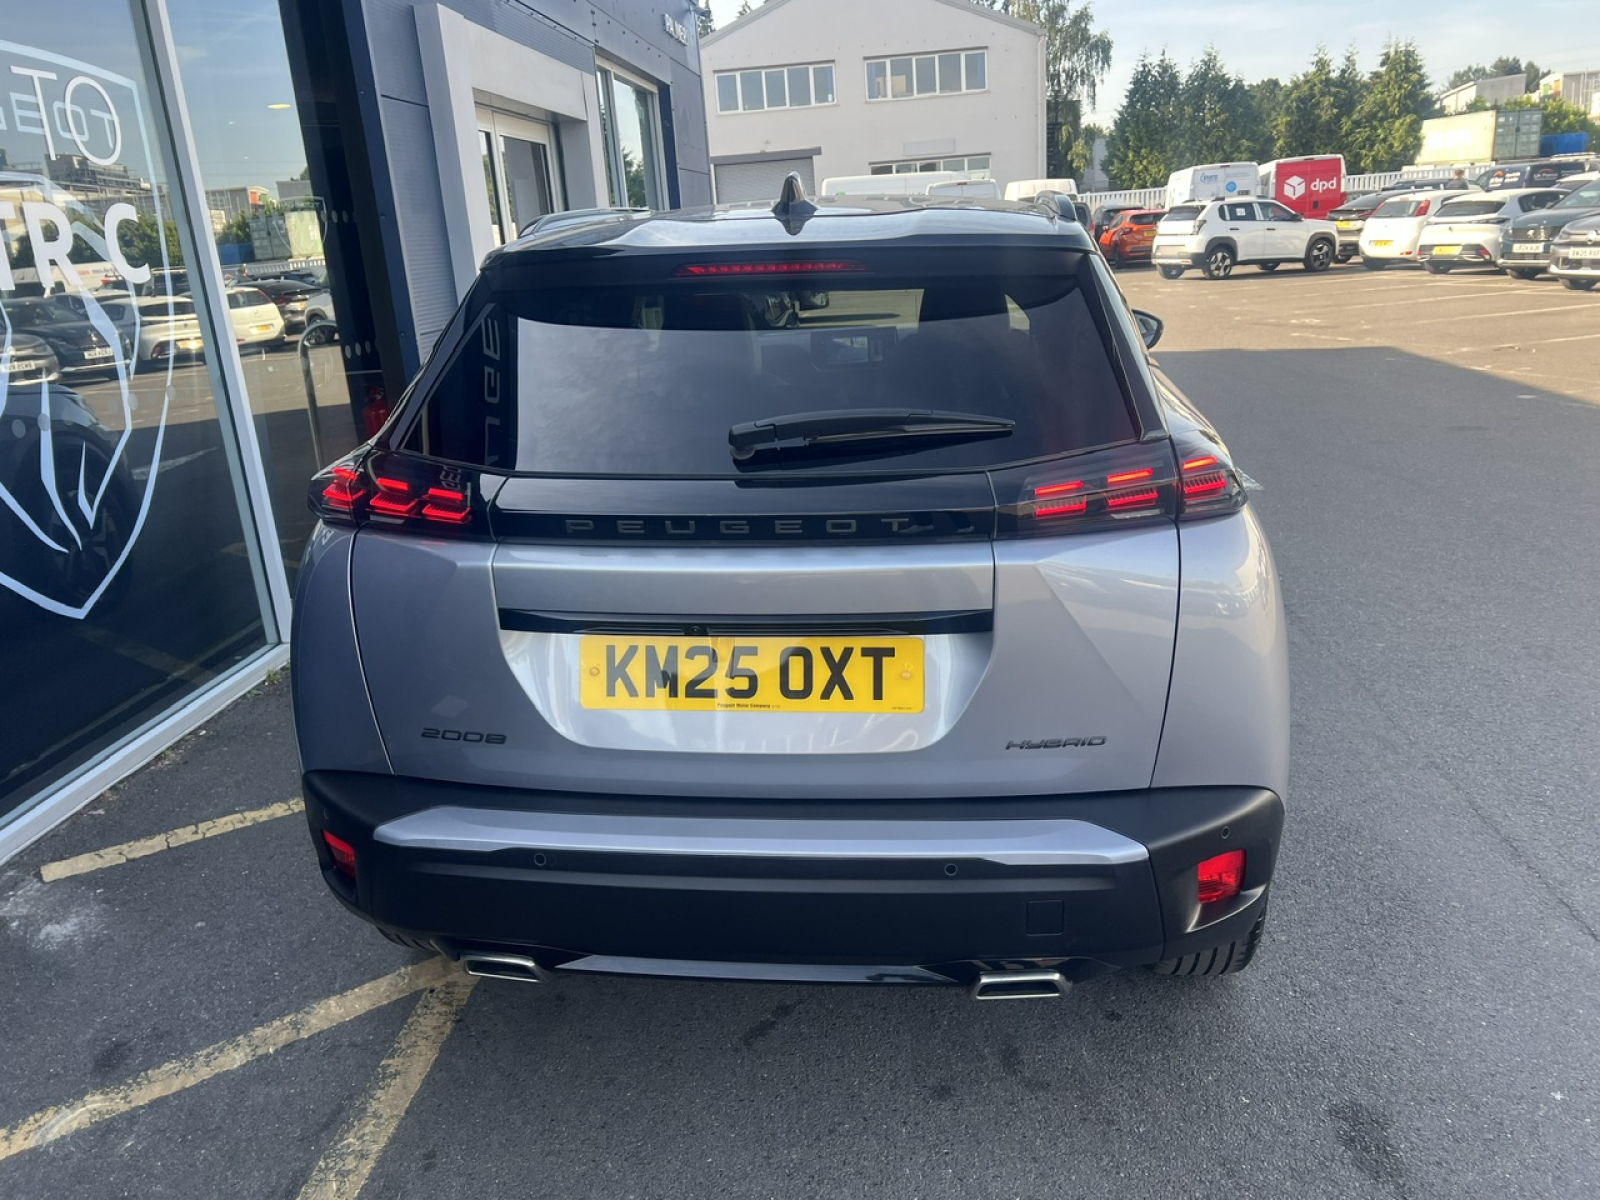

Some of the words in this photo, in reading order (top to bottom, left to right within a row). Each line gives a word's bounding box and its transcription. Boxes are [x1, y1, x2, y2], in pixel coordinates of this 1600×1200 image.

[1310, 177, 1337, 193] dpd
[565, 518, 910, 535] PEUGEOT
[605, 644, 759, 699] KM25
[779, 646, 896, 700] OXT
[421, 727, 507, 745] 2008
[1005, 735, 1108, 750] HYBRID
